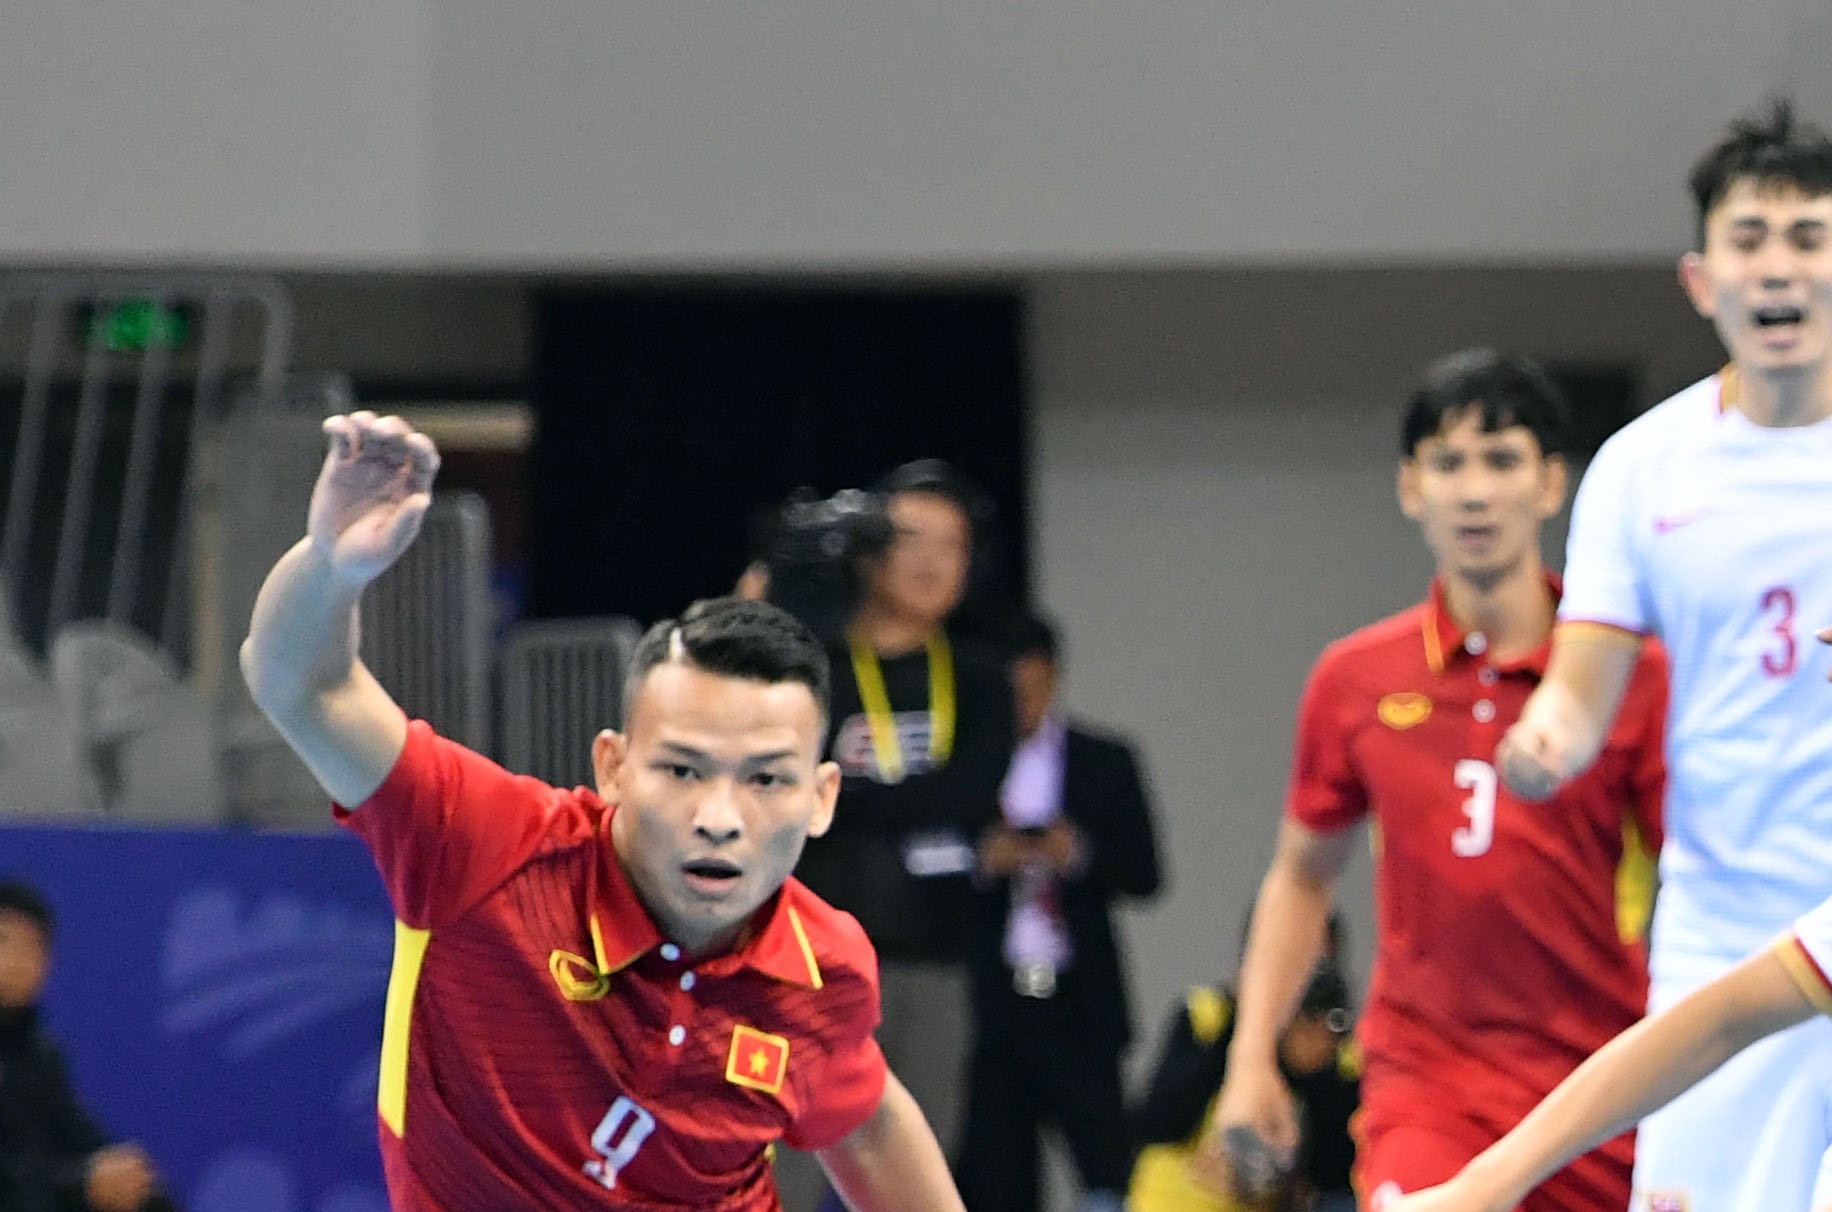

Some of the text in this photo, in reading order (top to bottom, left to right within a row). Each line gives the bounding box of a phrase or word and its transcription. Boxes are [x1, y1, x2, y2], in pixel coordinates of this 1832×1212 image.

[1759, 585, 1797, 679] 3
[1451, 759, 1498, 858] 3
[582, 1095, 656, 1190] 9
